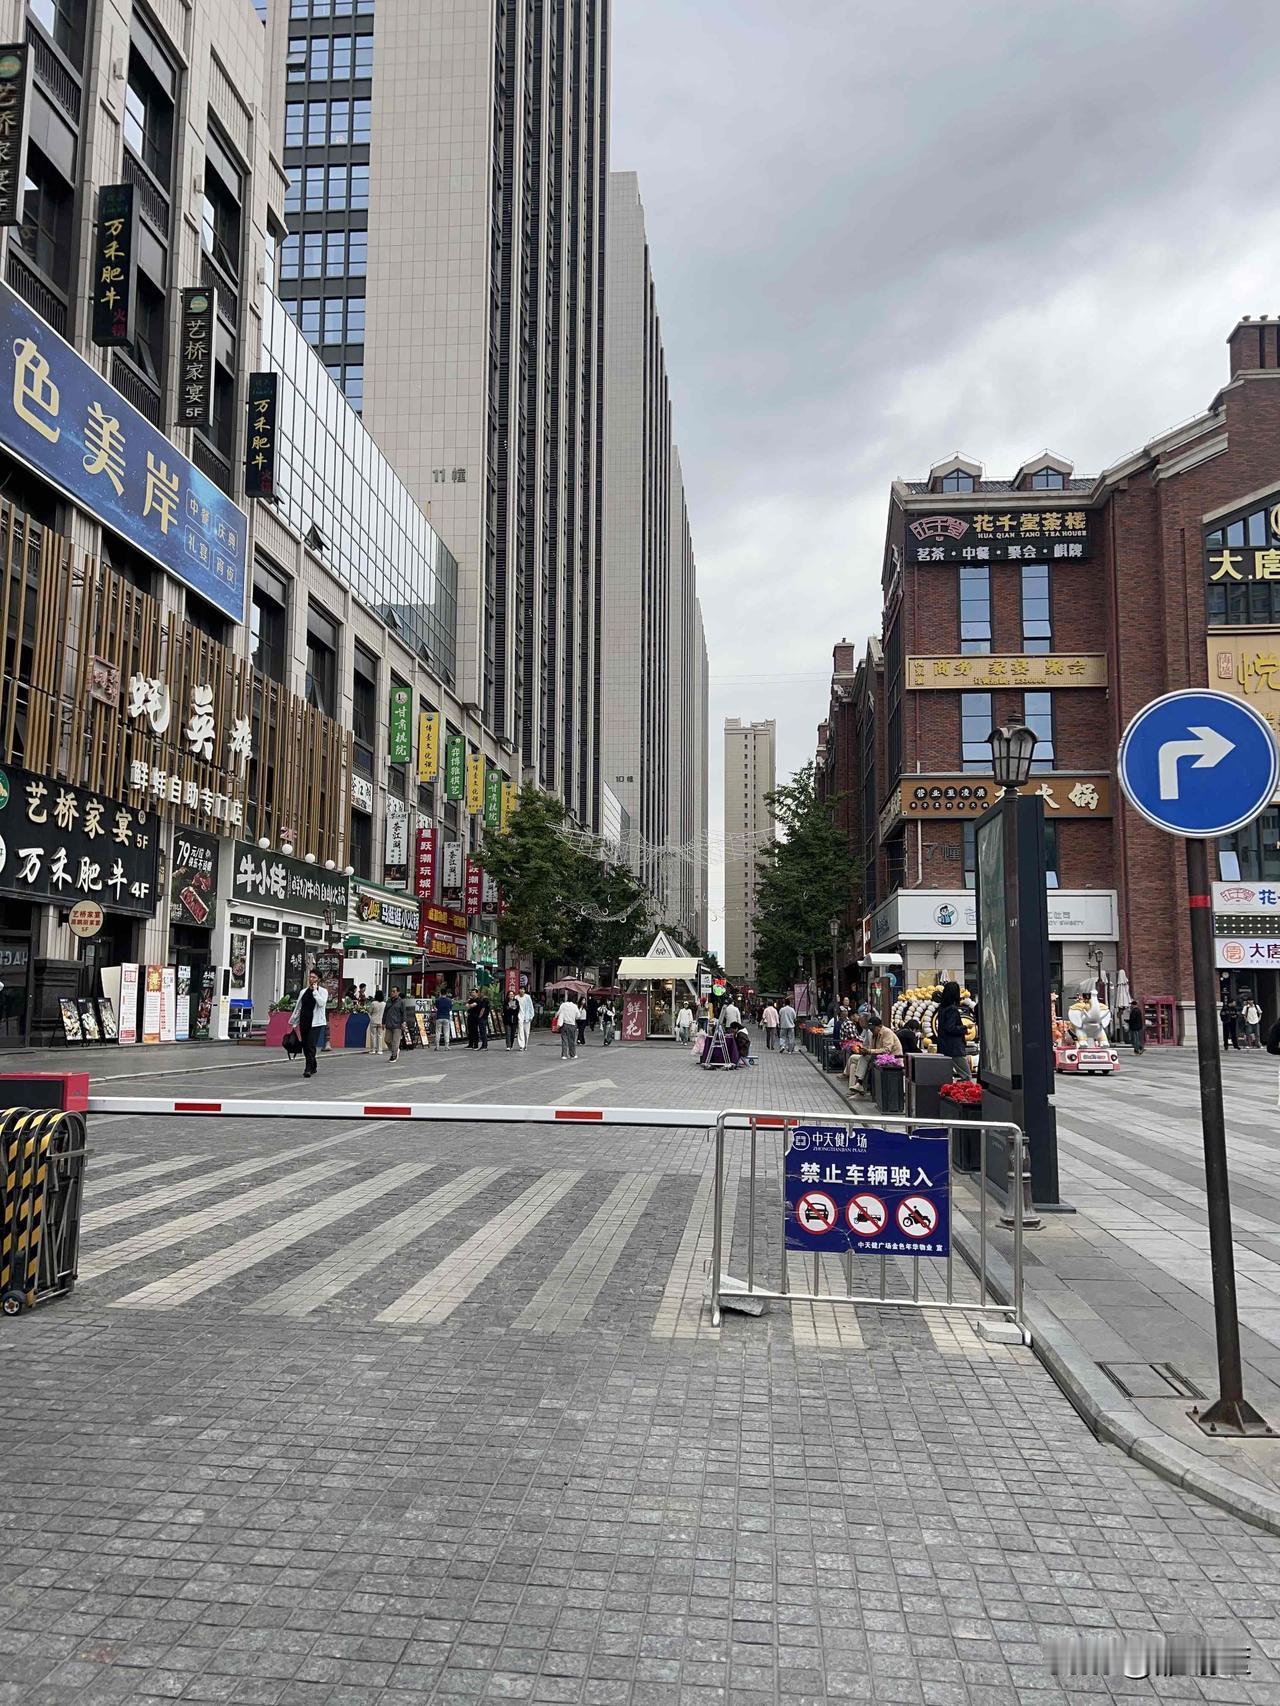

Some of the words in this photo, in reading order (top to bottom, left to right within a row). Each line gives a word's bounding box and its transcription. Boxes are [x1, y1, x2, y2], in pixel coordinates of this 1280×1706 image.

[101, 218, 125, 310] 万禾肥牛
[184, 320, 208, 404] 艺桥家宴
[185, 407, 203, 418] 5F
[13, 338, 179, 535] 色美岸
[251, 400, 270, 471] 万禾肥牛
[973, 512, 1086, 533] 花千堂茶楼
[917, 547, 945, 561] 茗茶
[962, 546, 990, 560] 中餐
[1008, 544, 1037, 559] 聚会
[26, 781, 132, 847] 艺桥家宴
[136, 834, 148, 849] 5F
[17, 846, 128, 900] 万禾肥牛
[131, 881, 149, 898] 4F
[419, 890, 431, 898] 2F
[625, 1002, 642, 1036] 鲜花
[800, 1162, 934, 1188] 禁止车辆驶入
